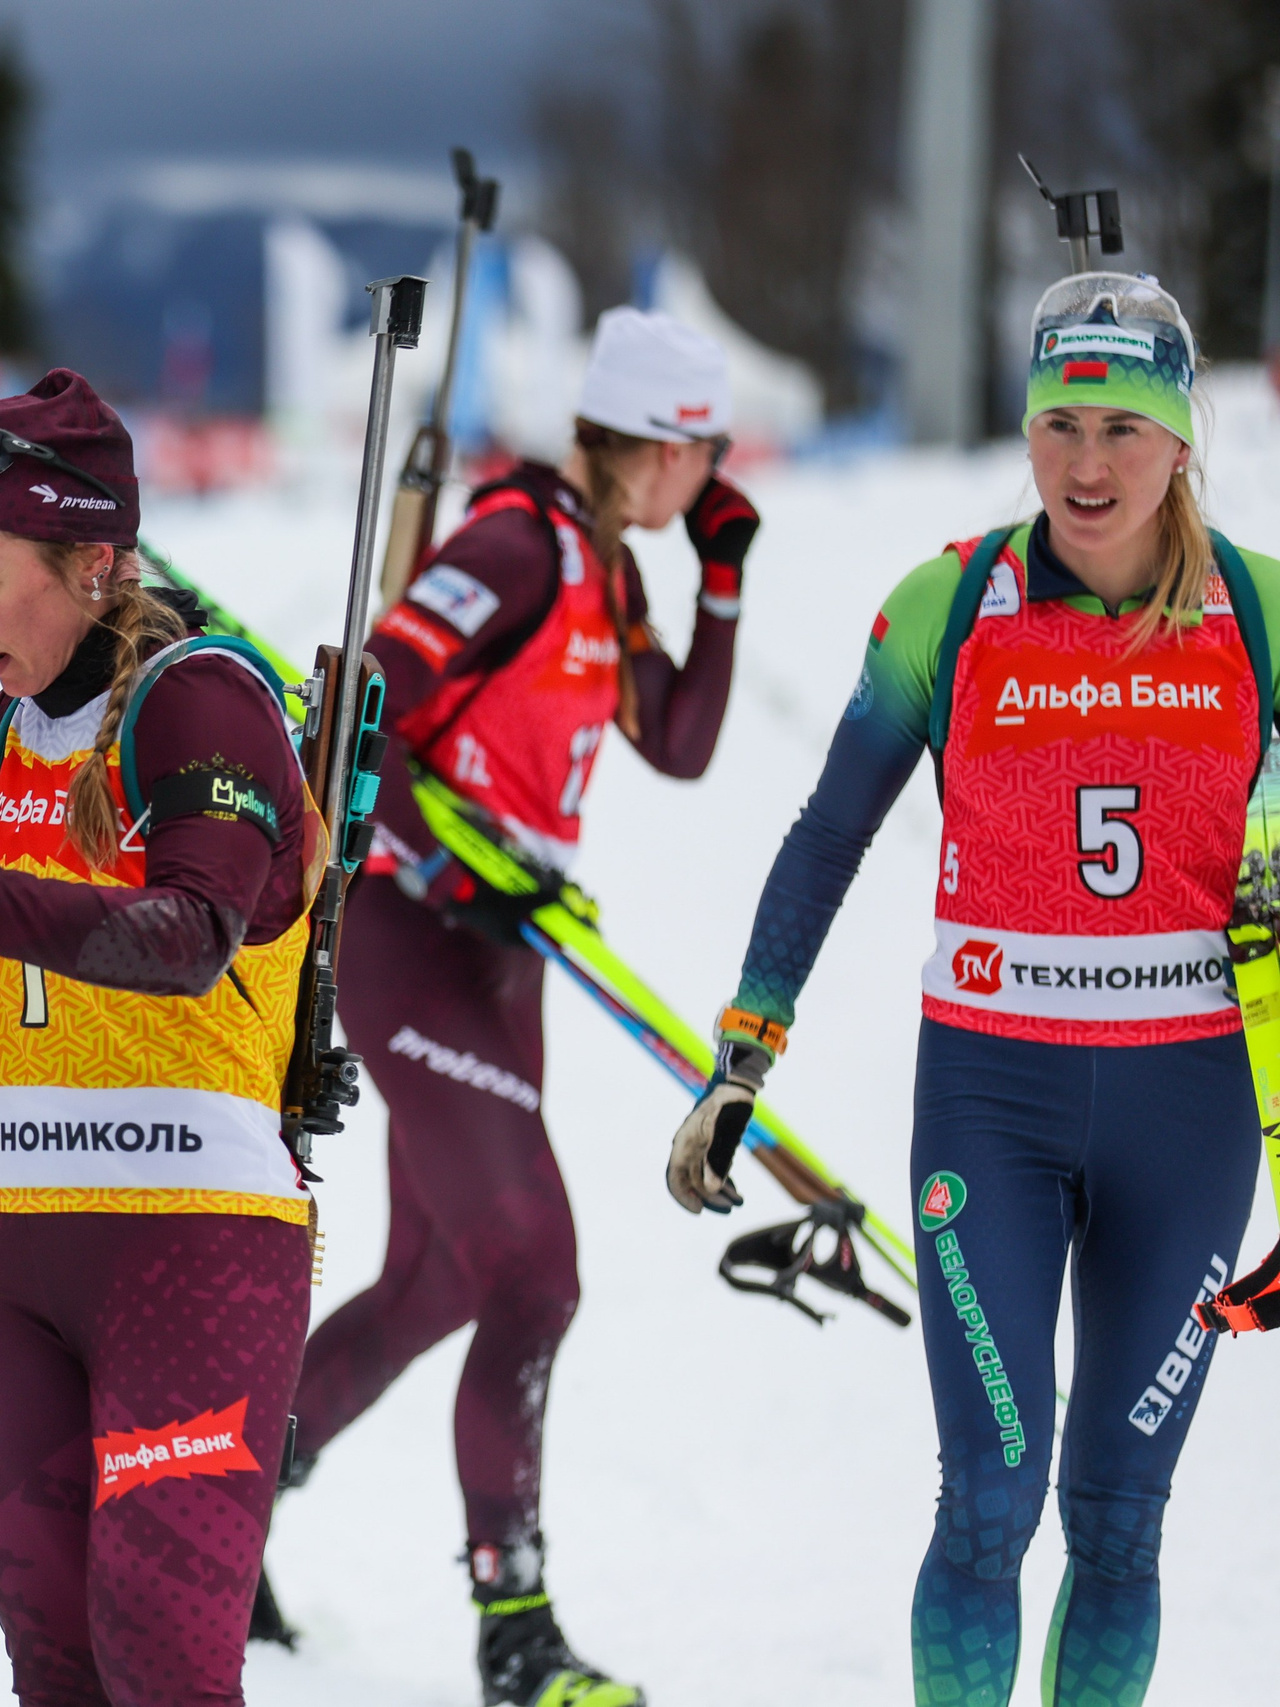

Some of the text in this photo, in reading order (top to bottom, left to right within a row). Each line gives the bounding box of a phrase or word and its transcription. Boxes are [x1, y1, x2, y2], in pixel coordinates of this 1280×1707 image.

[59, 496, 117, 510] proteam
[996, 674, 1223, 718] Альфа Банк
[234, 789, 266, 818] yellow
[1075, 784, 1145, 900] 5
[943, 840, 960, 895] 5
[1010, 956, 1223, 990] ТЕХНОНИКО
[934, 1229, 1026, 1468] БЕЛОРУСНЕФТЬ
[103, 1431, 235, 1476] Альфа Банк
